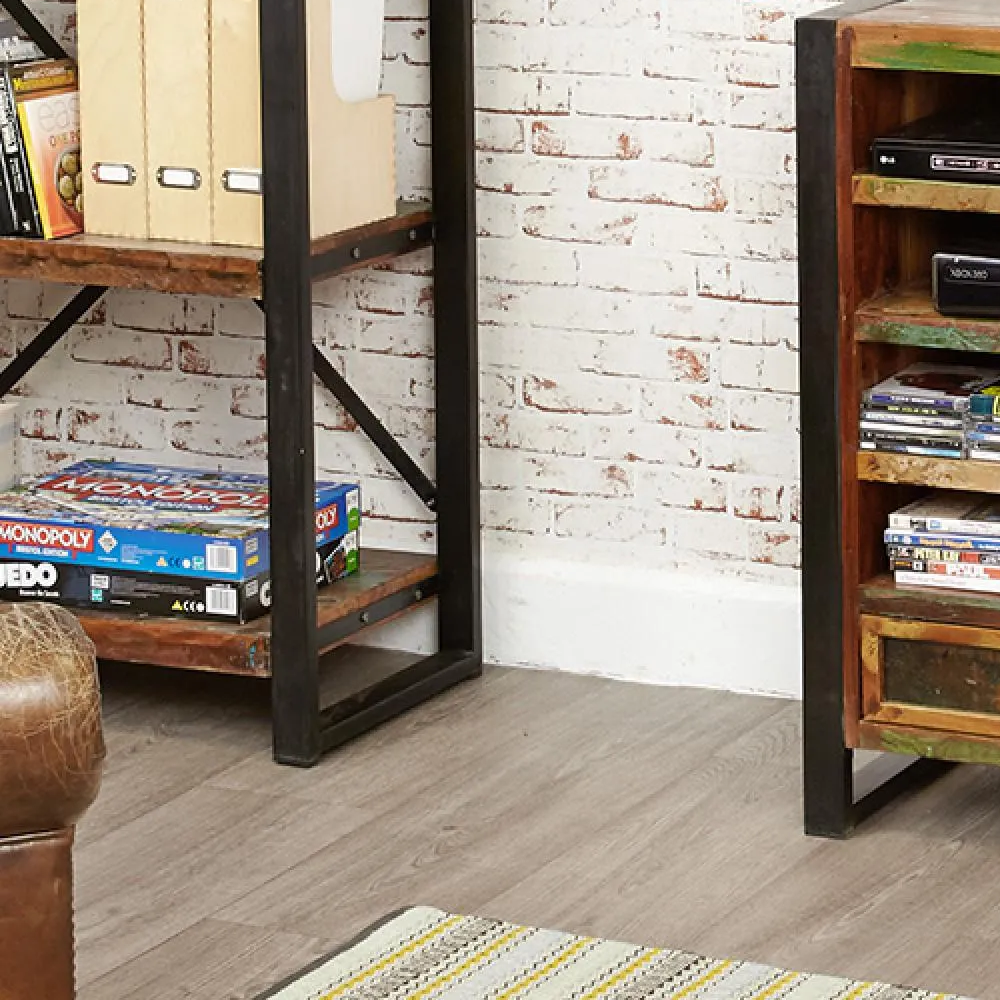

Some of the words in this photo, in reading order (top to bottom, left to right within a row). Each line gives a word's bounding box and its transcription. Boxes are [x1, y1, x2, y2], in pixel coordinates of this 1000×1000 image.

[52, 478, 268, 507] MONOPOL
[0, 525, 90, 549] MONOPOLY
[0, 562, 58, 588] EDO
